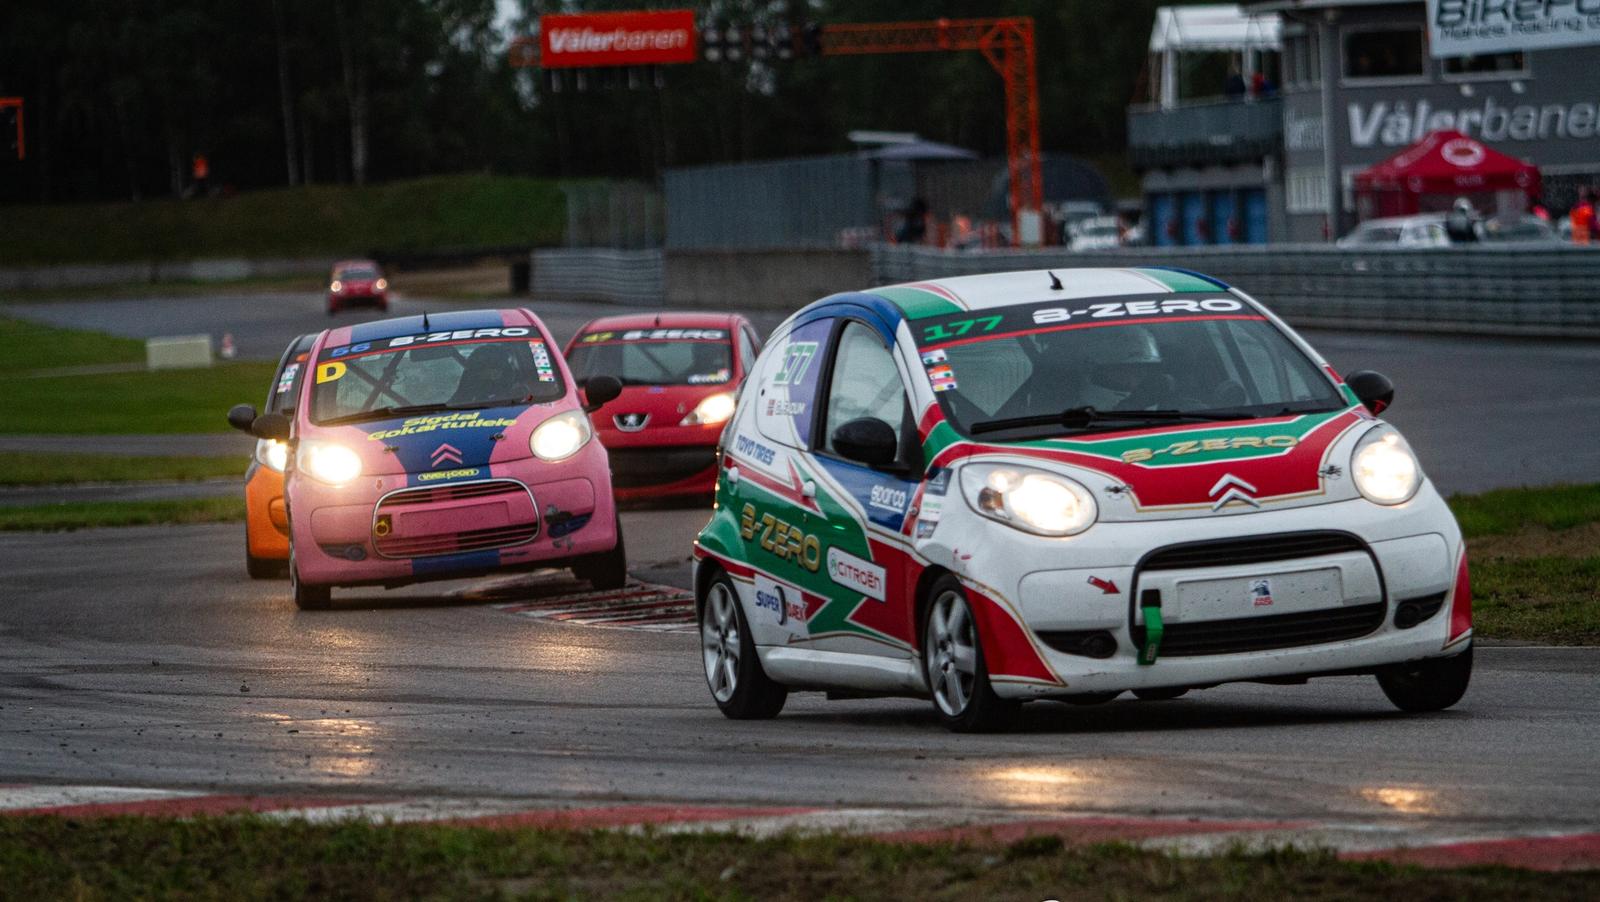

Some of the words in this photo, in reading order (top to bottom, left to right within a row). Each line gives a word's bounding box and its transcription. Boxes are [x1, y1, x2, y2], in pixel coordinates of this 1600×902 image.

[1348, 97, 1600, 146] Vålerbane
[923, 315, 1004, 341] 177
[1032, 299, 1242, 325] B-ZERO
[330, 342, 372, 358] 56
[388, 327, 529, 348] B-ZERO
[316, 361, 347, 385] D
[773, 341, 819, 385] 177
[403, 411, 481, 428] Sigdal
[736, 434, 756, 456] TOYO
[752, 442, 776, 466] TIRES
[1120, 435, 1298, 464] B-ZERO
[871, 484, 907, 509] sparco
[741, 502, 821, 572] B-ZERO
[755, 590, 780, 614] SUPER
